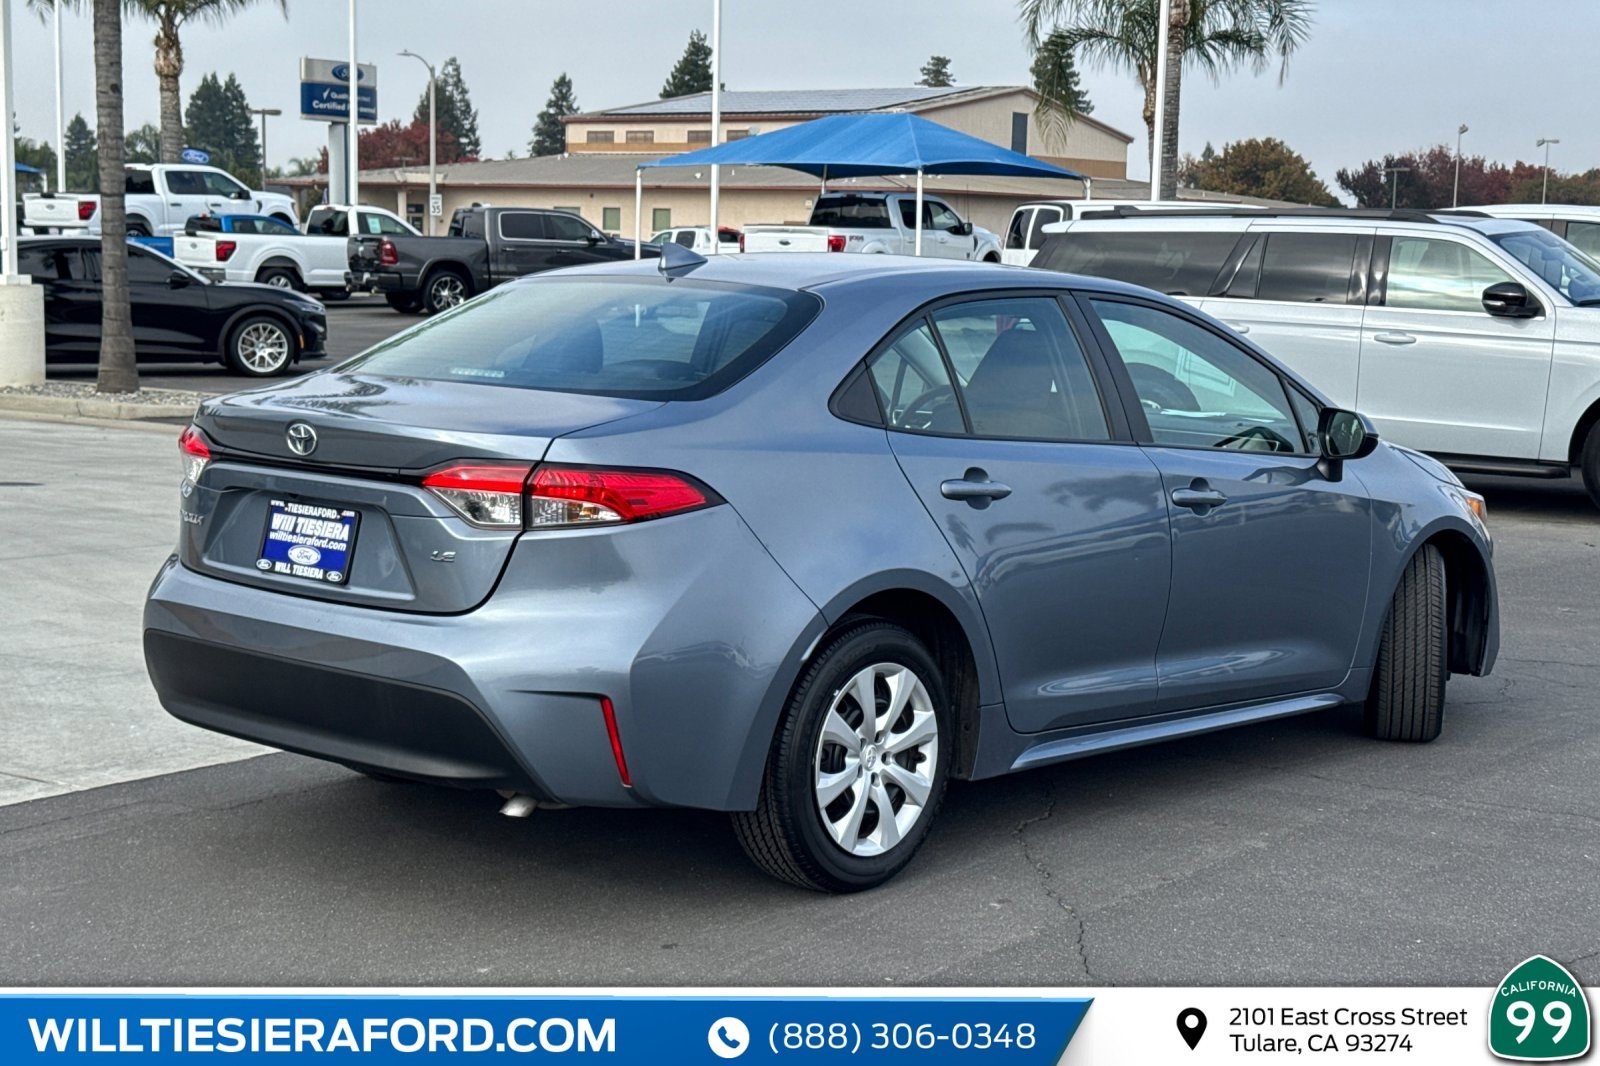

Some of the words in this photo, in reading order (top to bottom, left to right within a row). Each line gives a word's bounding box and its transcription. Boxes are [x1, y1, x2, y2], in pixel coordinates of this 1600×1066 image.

[312, 100, 346, 111] Certified
[432, 204, 440, 214] 35
[296, 516, 349, 541] TIESIERA
[269, 531, 346, 551] willtiesieraford.com
[274, 562, 291, 574] WILL
[292, 565, 323, 579] TIESIERA
